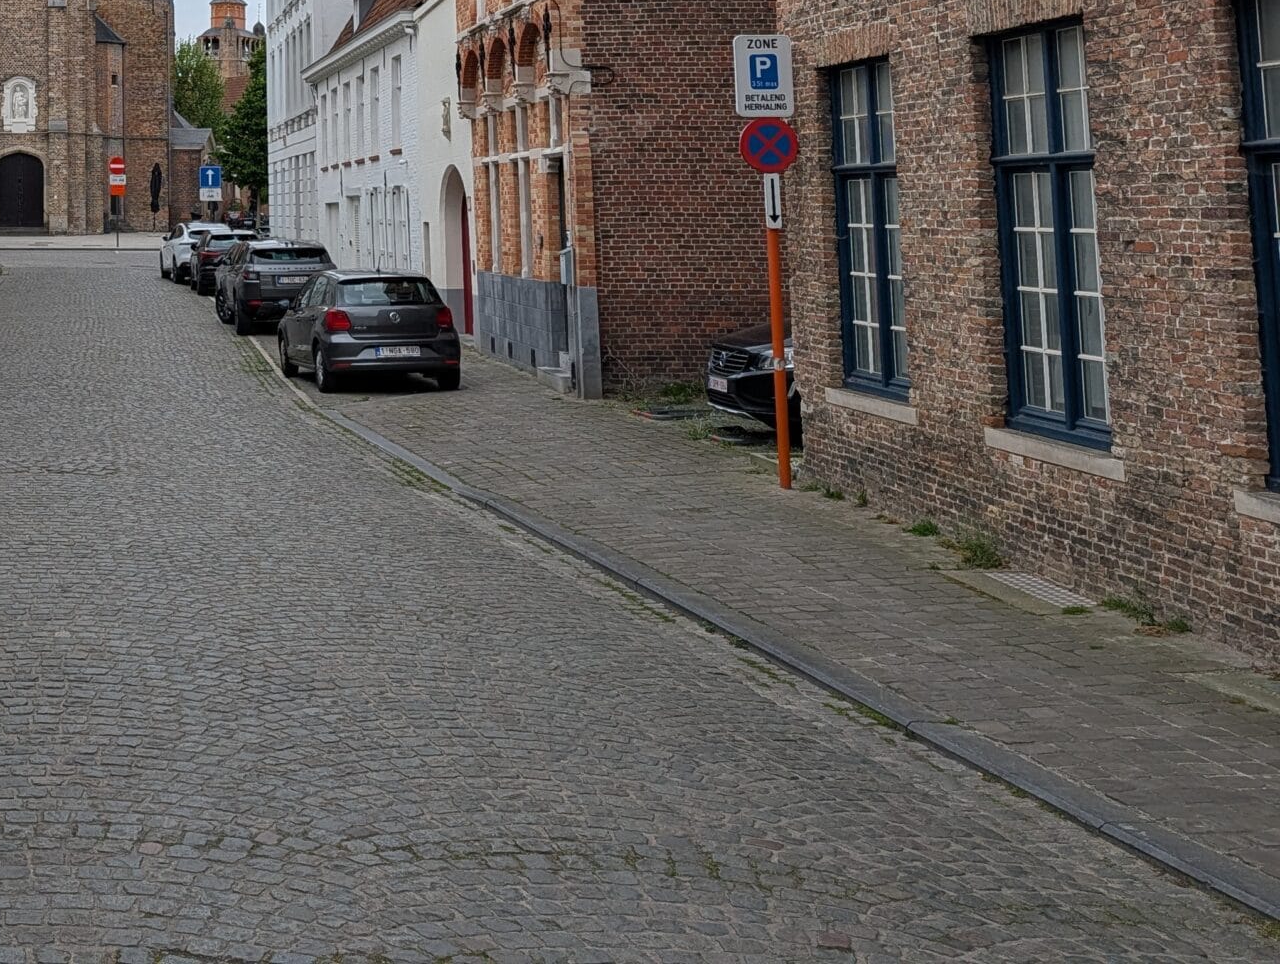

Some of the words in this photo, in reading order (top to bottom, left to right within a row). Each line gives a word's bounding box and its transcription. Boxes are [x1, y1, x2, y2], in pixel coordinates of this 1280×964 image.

[747, 39, 778, 49] ZONE
[755, 57, 771, 78] P
[745, 94, 786, 102] BETALEND
[744, 103, 787, 111] HERHALING
